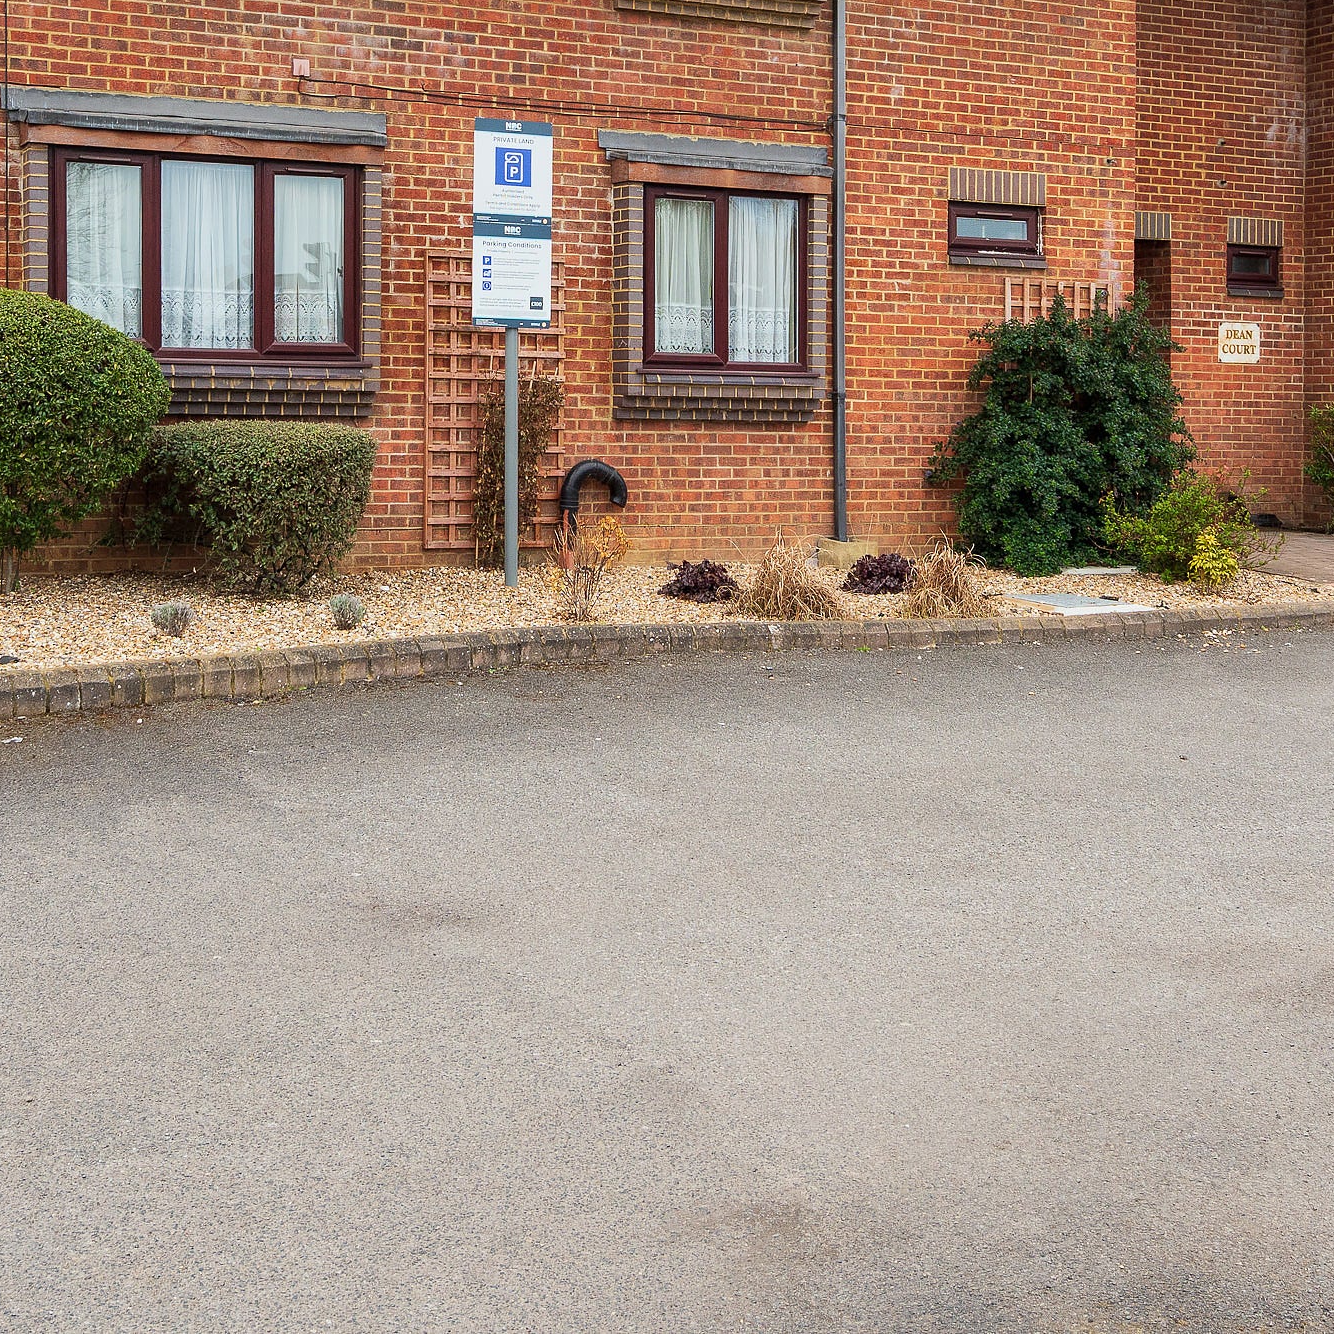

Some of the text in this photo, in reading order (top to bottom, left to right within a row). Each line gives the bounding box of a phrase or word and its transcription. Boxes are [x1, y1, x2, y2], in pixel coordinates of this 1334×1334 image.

[482, 240, 542, 249] Parking Conditions
[1226, 329, 1253, 339] DEAN
[1222, 344, 1256, 355] COURT
